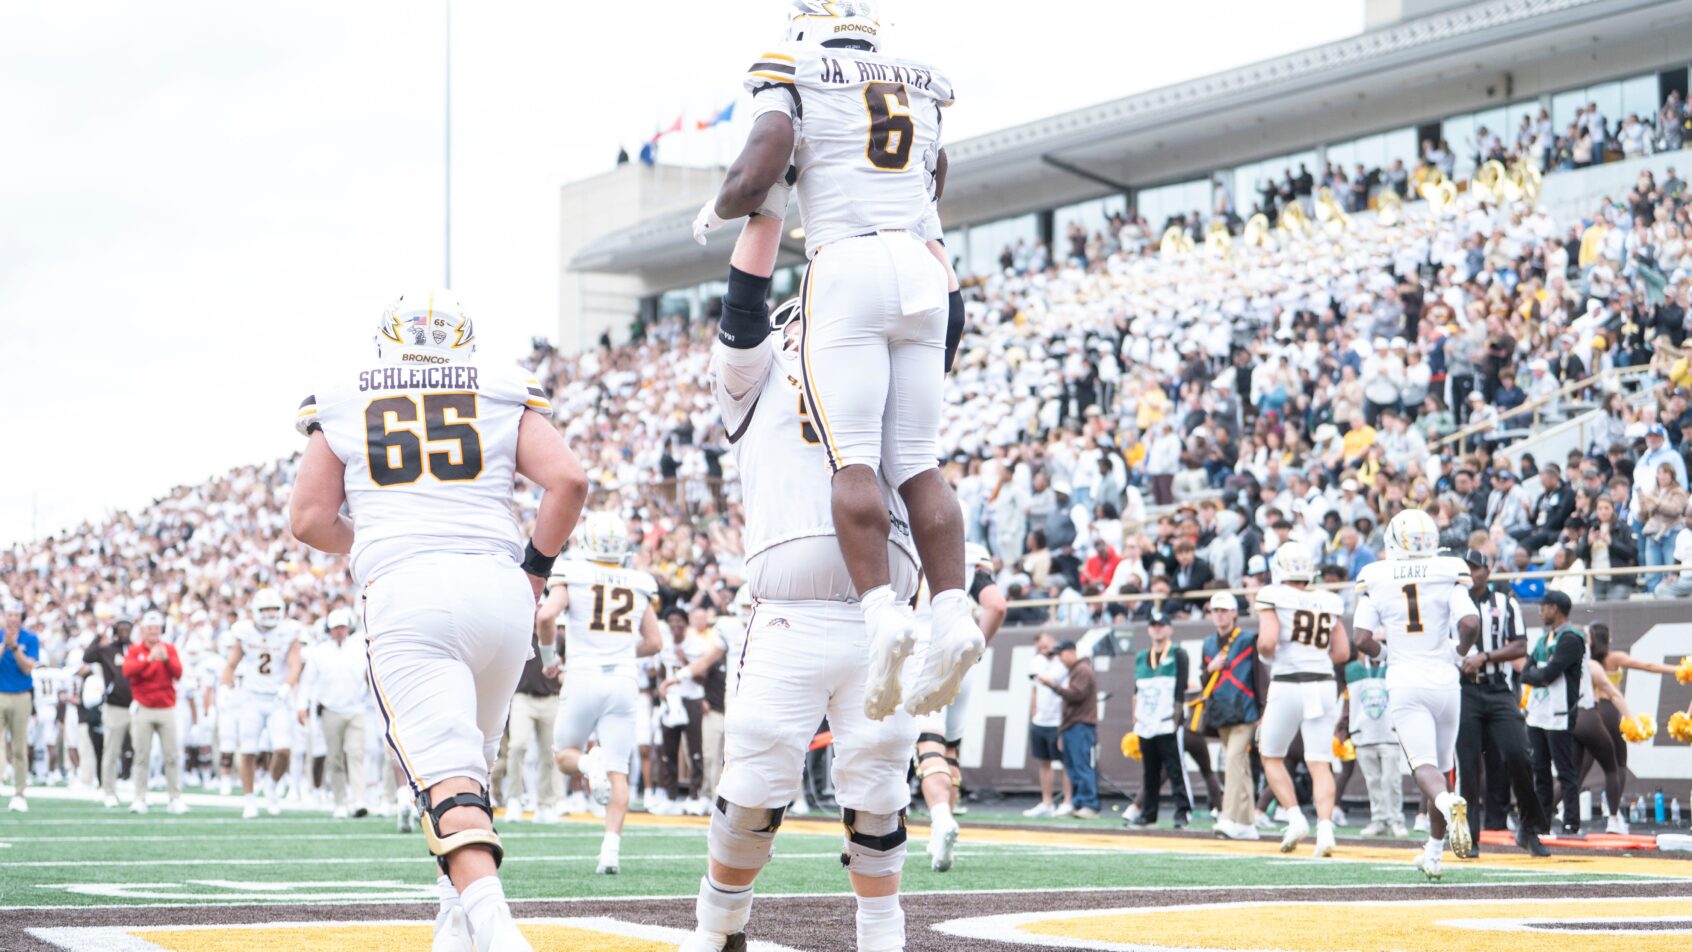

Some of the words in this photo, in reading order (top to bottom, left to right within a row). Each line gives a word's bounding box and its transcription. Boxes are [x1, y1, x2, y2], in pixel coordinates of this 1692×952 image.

[833, 23, 877, 36] BRONCOS
[820, 57, 850, 84] JA.
[863, 80, 915, 172] 6
[434, 318, 446, 327] 65
[401, 353, 451, 365] BRONCOS
[358, 366, 480, 391] SCHLEICHER
[364, 391, 485, 488] 65
[1393, 564, 1429, 580] LEARY
[589, 584, 634, 633] 12
[1401, 581, 1425, 634] 1
[1290, 609, 1331, 650] 86
[258, 652, 272, 675] 2
